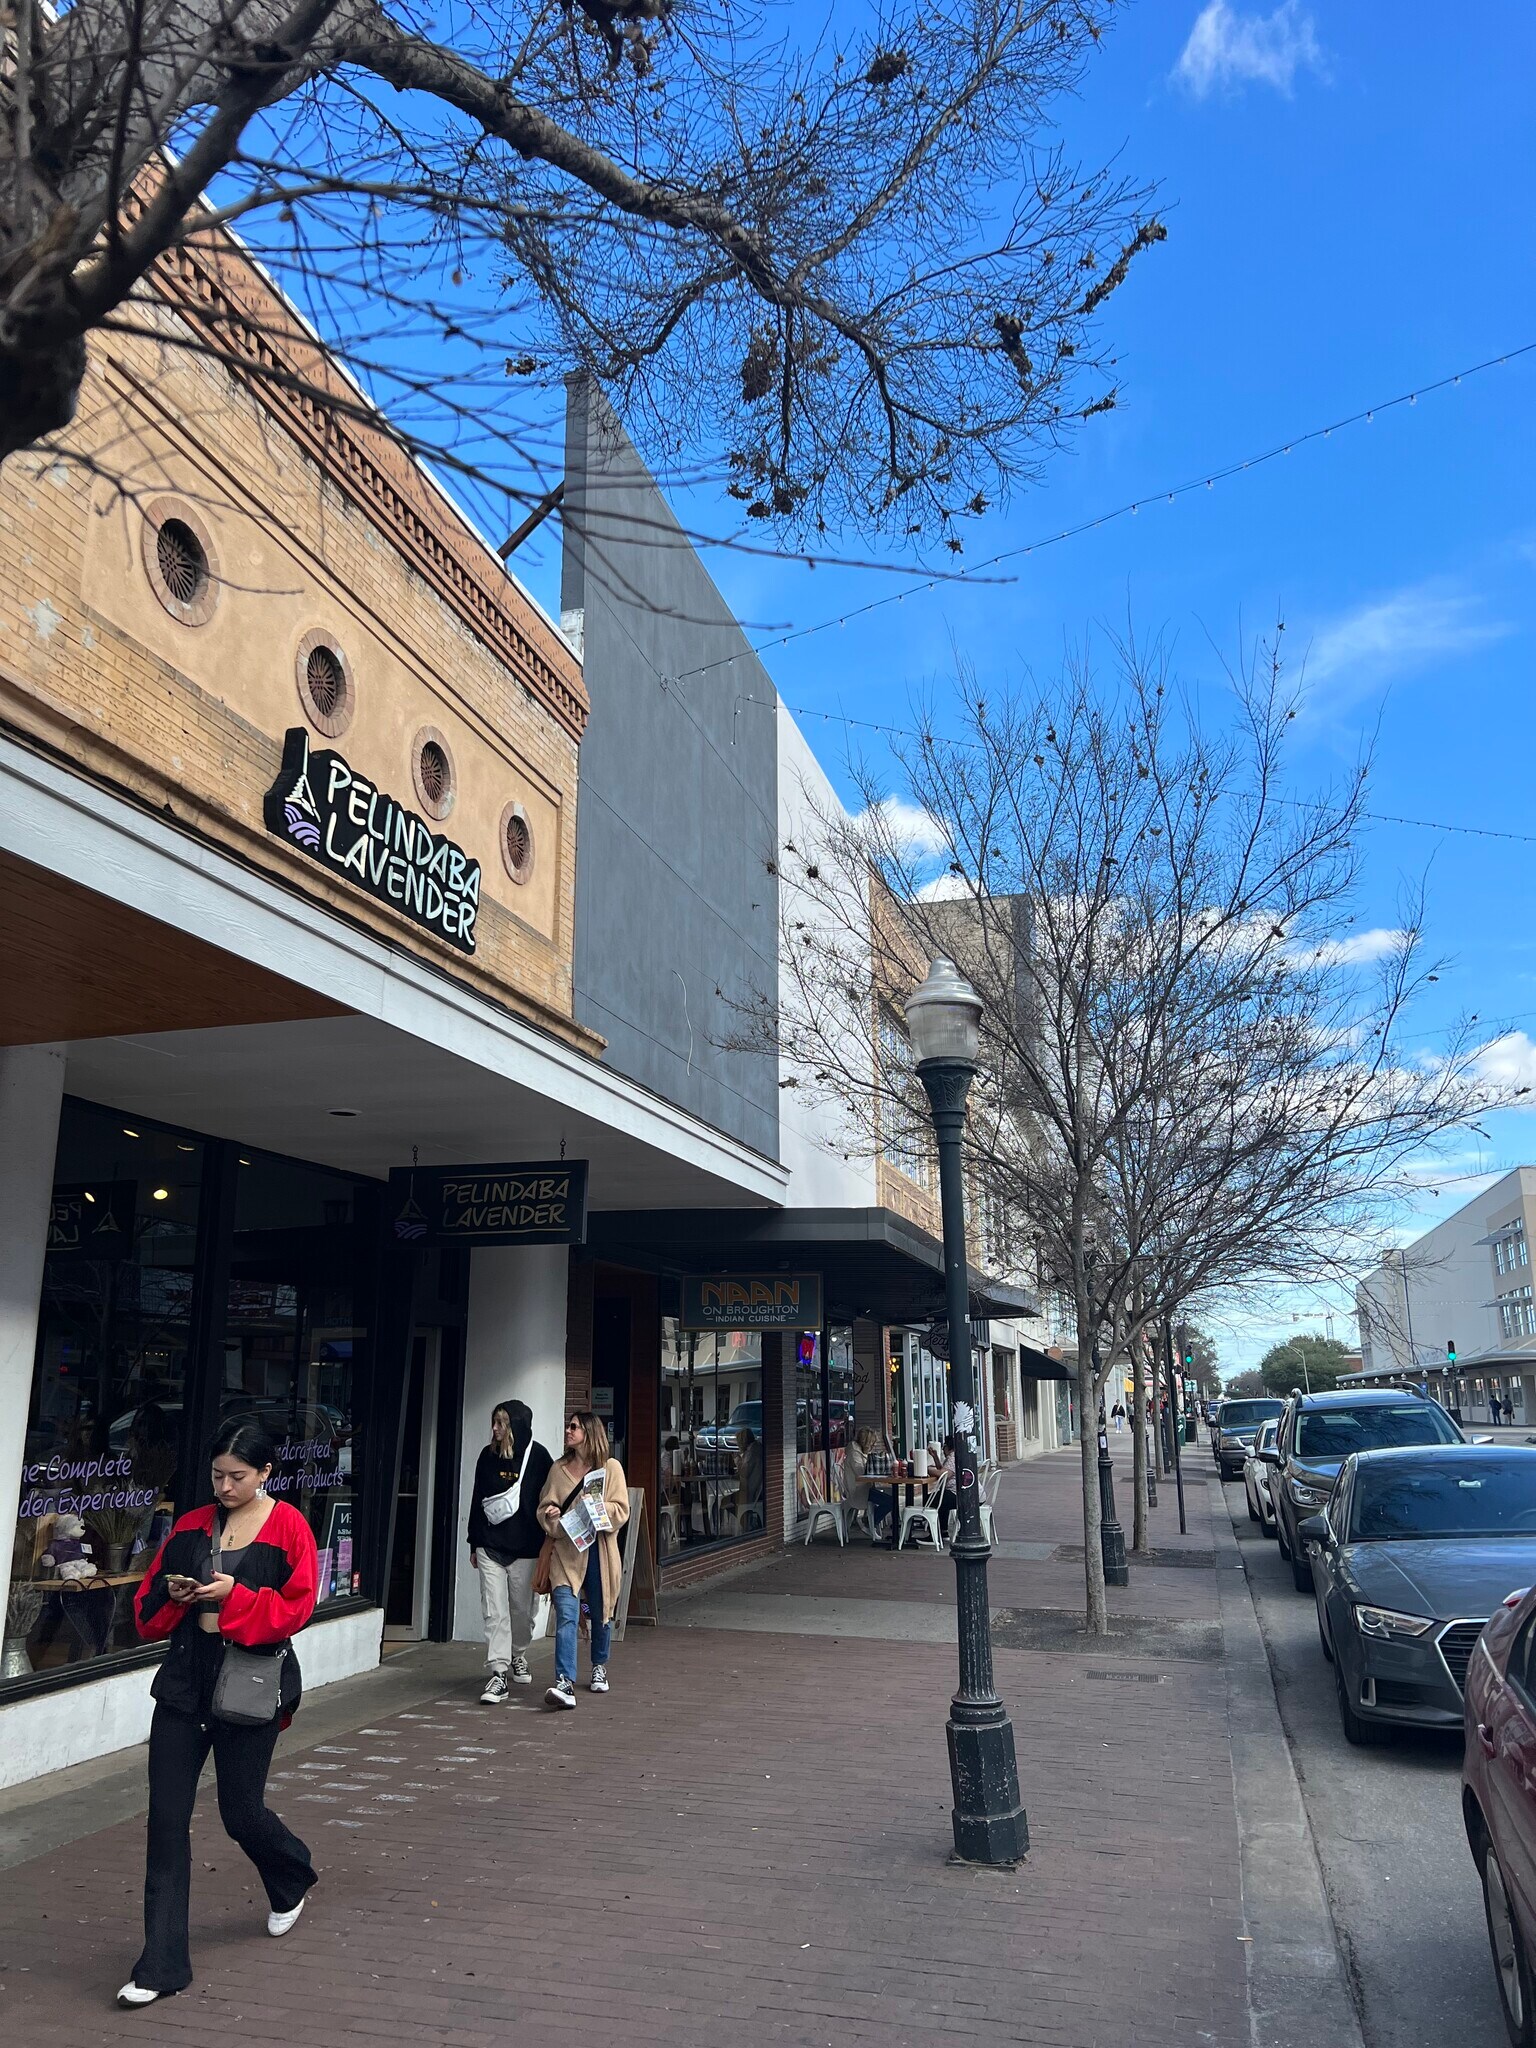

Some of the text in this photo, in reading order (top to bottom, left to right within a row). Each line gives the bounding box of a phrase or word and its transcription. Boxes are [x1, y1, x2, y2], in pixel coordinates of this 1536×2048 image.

[328, 759, 480, 905] PELINDABA
[326, 812, 475, 946] LAVENDER
[443, 1179, 570, 1203] PELINDABA
[442, 1203, 566, 1228] LAVENDER
[701, 1281, 800, 1305] NAAN
[702, 1305, 799, 1315] ON BROUGHTON
[715, 1315, 745, 1323] INDIAN
[46, 1452, 132, 1486] Complete
[296, 1466, 343, 1489] Products
[19, 1489, 53, 1518] der
